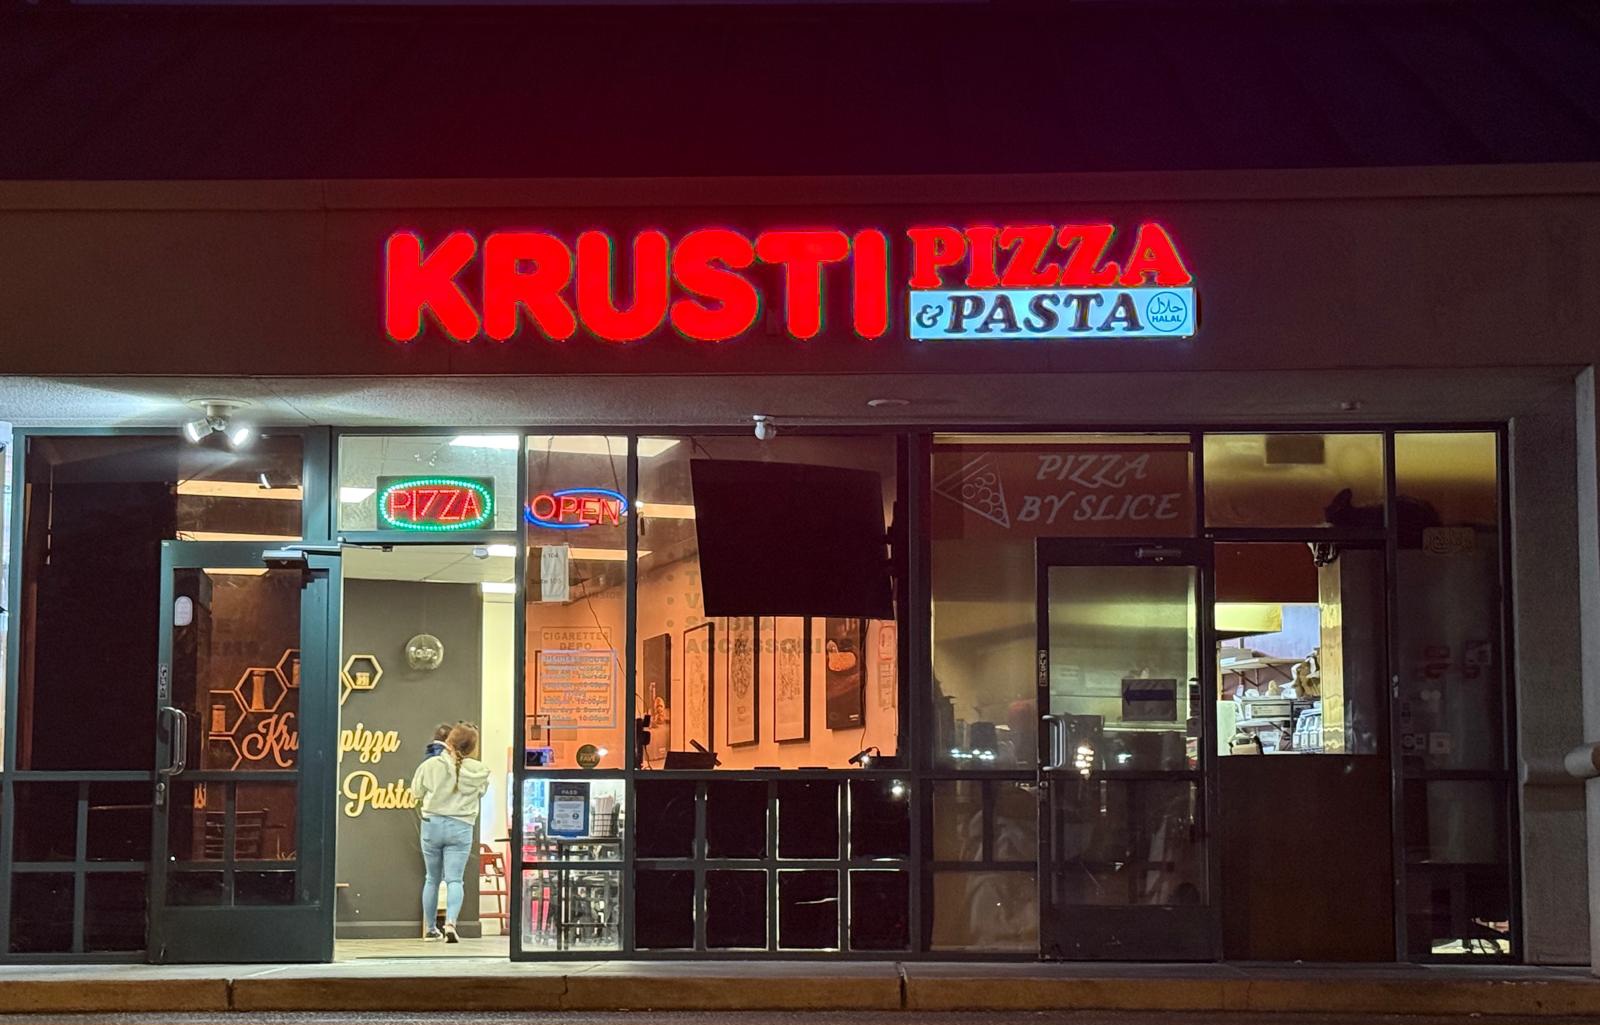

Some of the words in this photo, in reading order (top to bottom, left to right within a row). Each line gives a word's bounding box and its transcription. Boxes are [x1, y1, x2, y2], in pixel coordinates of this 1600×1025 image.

[907, 223, 1192, 287] PIZZA
[384, 228, 889, 341] KRUSTI
[915, 304, 944, 328] &
[944, 292, 1145, 333] PASTA
[1150, 296, 1183, 315] حلال
[1036, 453, 1150, 488] PIZZA
[389, 489, 480, 521] PIZZA
[531, 494, 620, 526] OPEN
[1017, 491, 1076, 524] BY
[1073, 493, 1181, 521] SLICE
[338, 722, 401, 763] pizza
